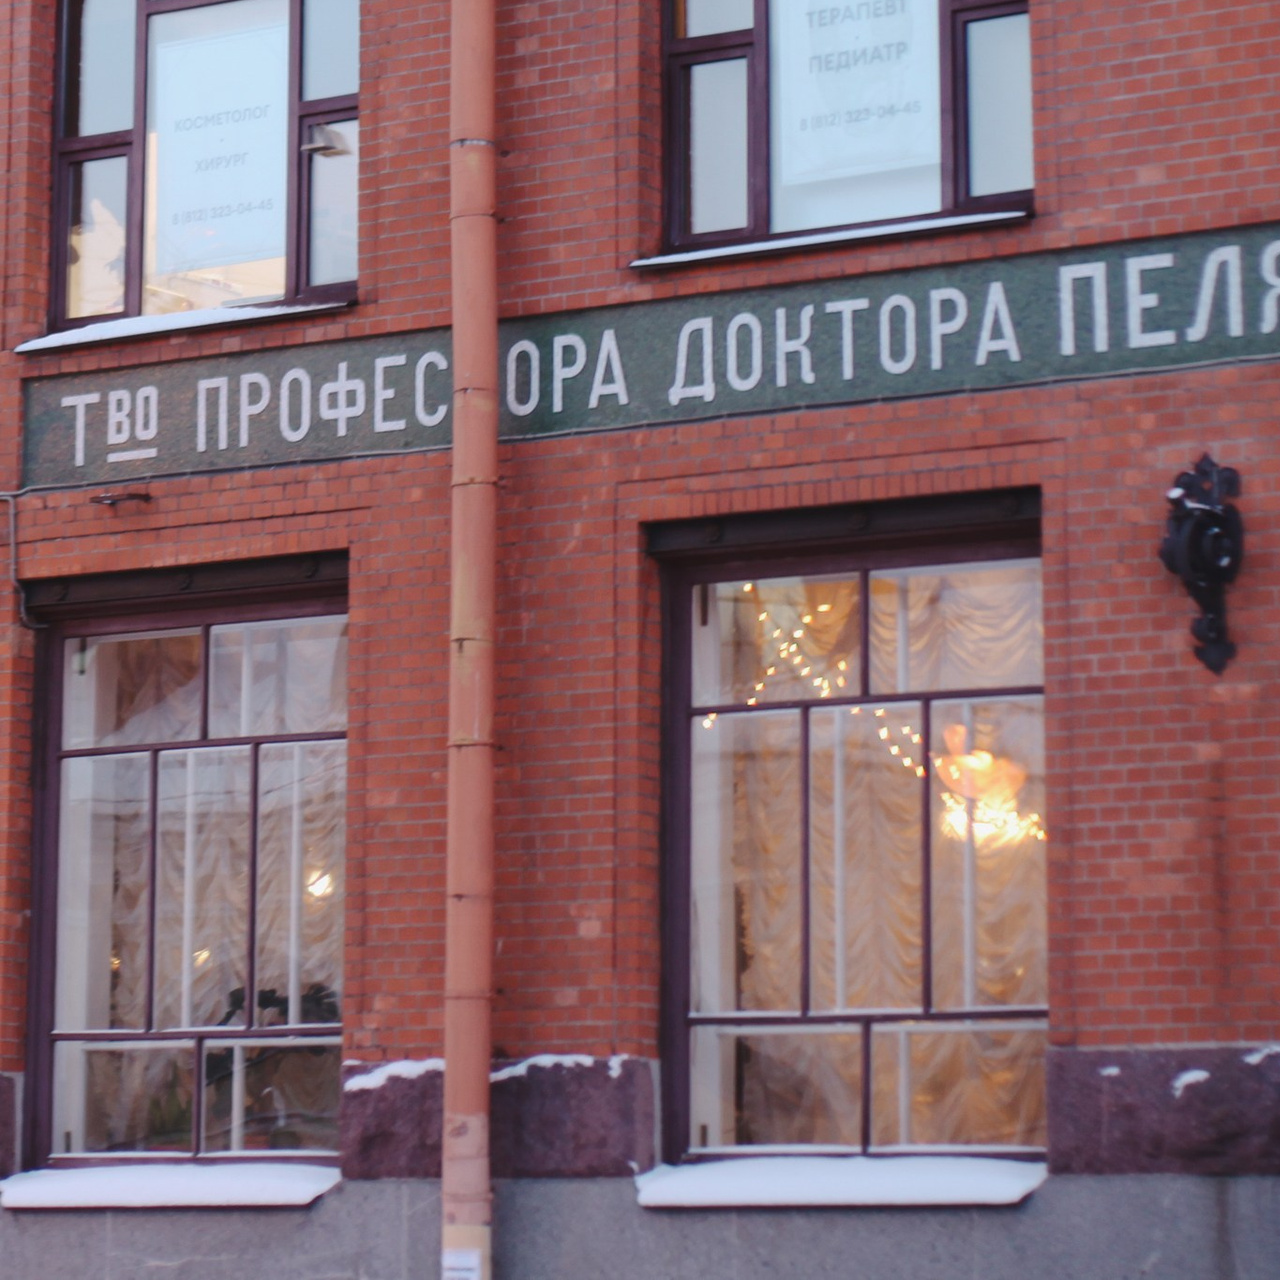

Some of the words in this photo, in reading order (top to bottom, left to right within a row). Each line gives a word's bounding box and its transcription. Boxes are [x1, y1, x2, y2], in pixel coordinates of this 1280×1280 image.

[809, 41, 908, 74] ПЕДИАТР
[174, 104, 270, 133] КОСМЕТОЛОГ
[195, 152, 249, 173] ХИРУРГ
[196, 329, 628, 453] ПРОФЕСОРА
[668, 282, 1020, 406] ДОКТОРА
